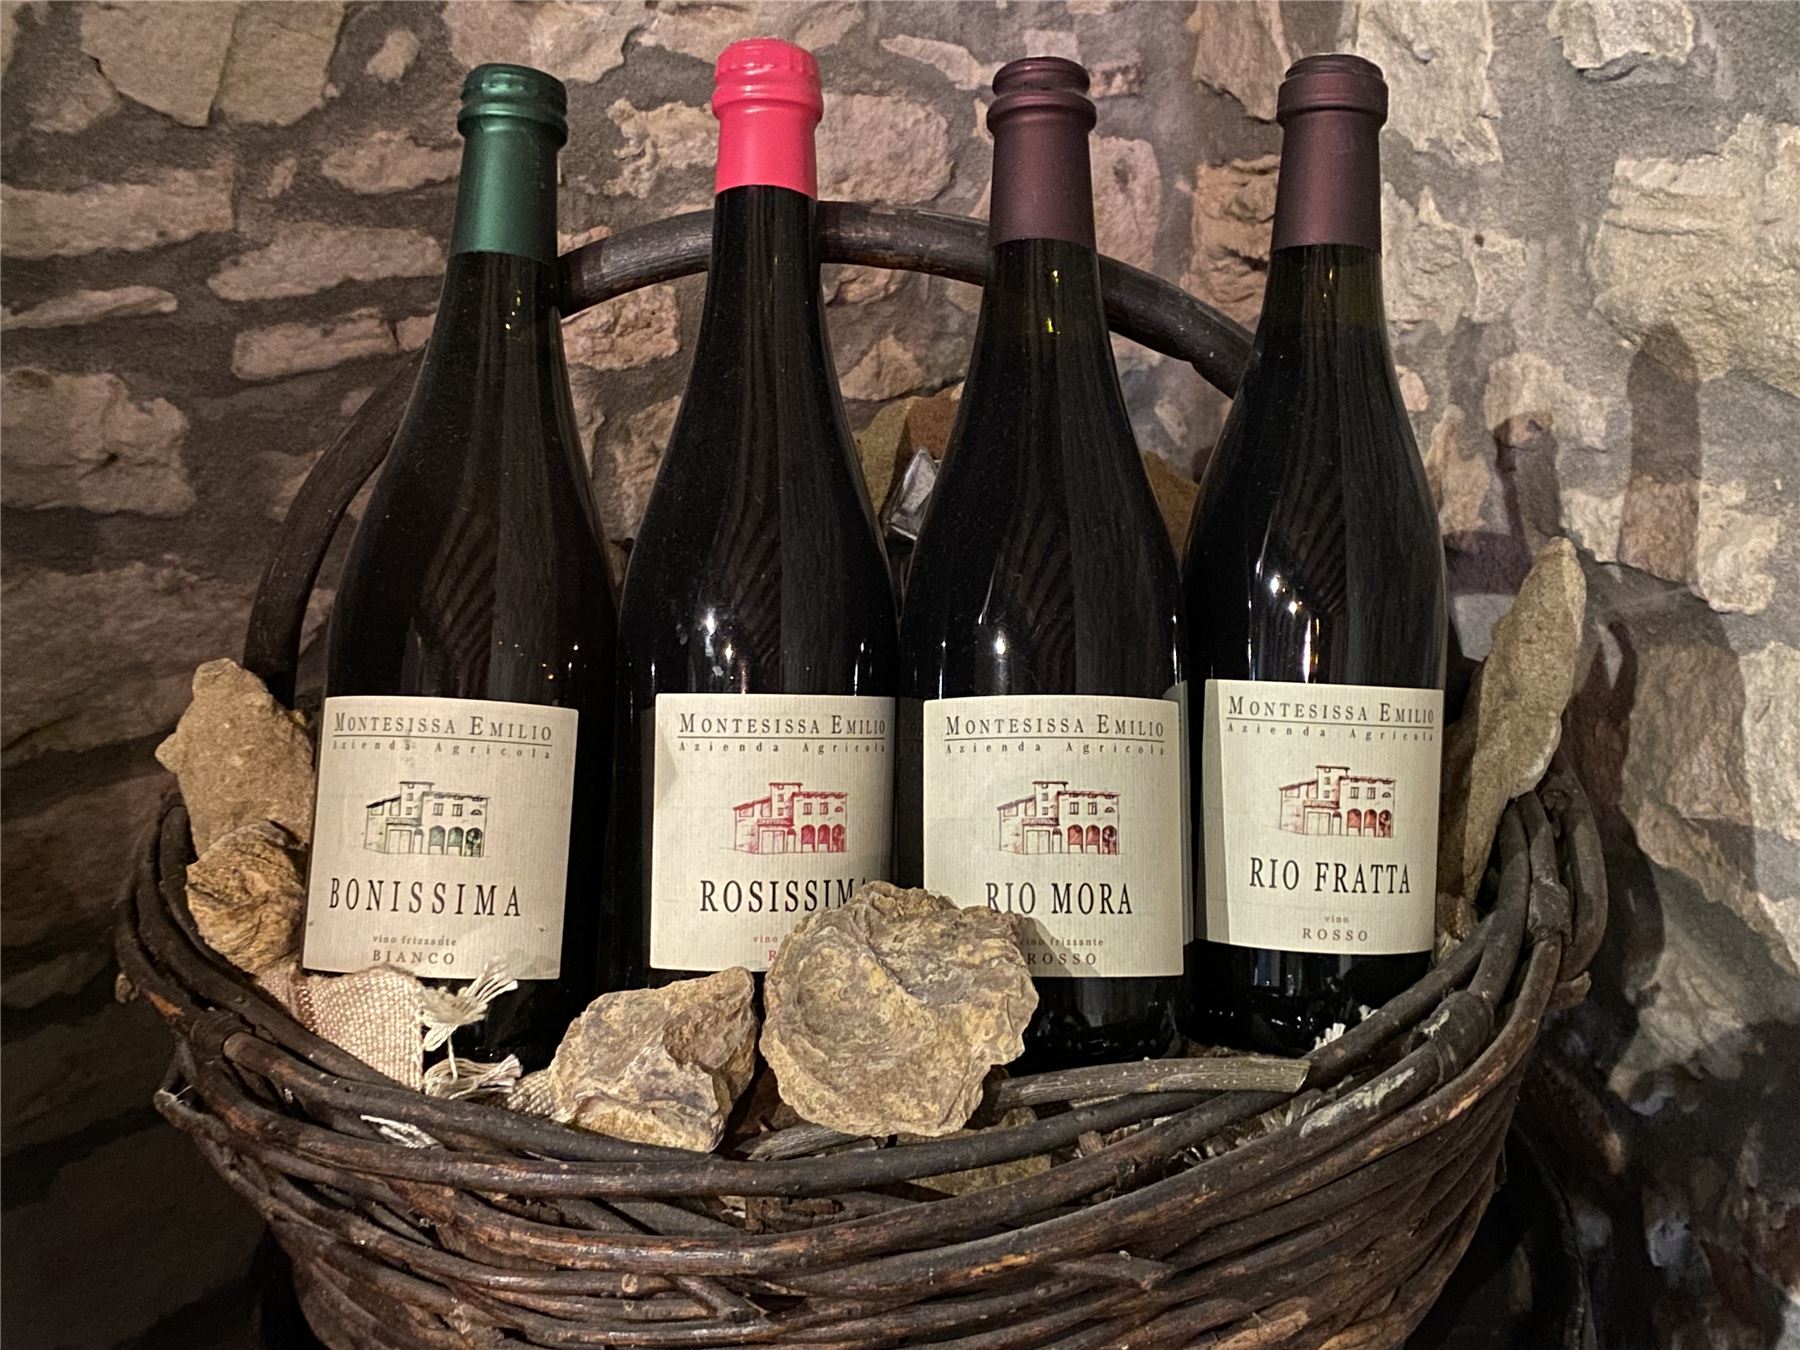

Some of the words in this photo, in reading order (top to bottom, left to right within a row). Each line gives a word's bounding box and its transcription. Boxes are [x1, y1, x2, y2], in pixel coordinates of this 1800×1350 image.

[1229, 696, 1368, 721] MONTESISSA
[1379, 702, 1434, 724] EMILIO
[334, 712, 456, 734] MONTESISSA
[469, 716, 552, 741] EMILIO
[679, 713, 820, 735] MONTESISSA
[831, 715, 886, 735] EMILIO
[946, 716, 1084, 736] MONTESISSA
[1096, 714, 1164, 737] EMILIO
[1227, 722, 1325, 737] Azienda
[1350, 728, 1433, 742] Agricola
[435, 742, 550, 760] Agricola
[679, 741, 779, 752] Azienda
[802, 742, 886, 755] Agricola
[945, 741, 1041, 754] Azienda
[1066, 742, 1164, 756] Agricola
[1249, 857, 1300, 890] RIO
[1314, 862, 1410, 894] FRATTA
[329, 877, 521, 917] BONISSIMA
[700, 878, 866, 913] ROSISSIM
[986, 881, 1037, 914] RIO
[1052, 882, 1133, 915] MORA
[1324, 914, 1350, 923] vino
[372, 935, 397, 944] vino
[401, 934, 457, 947] frizzante
[753, 935, 779, 943] vino
[1051, 937, 1104, 947] frizzante
[1302, 928, 1368, 942] ROSSO
[372, 950, 455, 965] BIANCO
[1027, 952, 1097, 965] ROSSO
